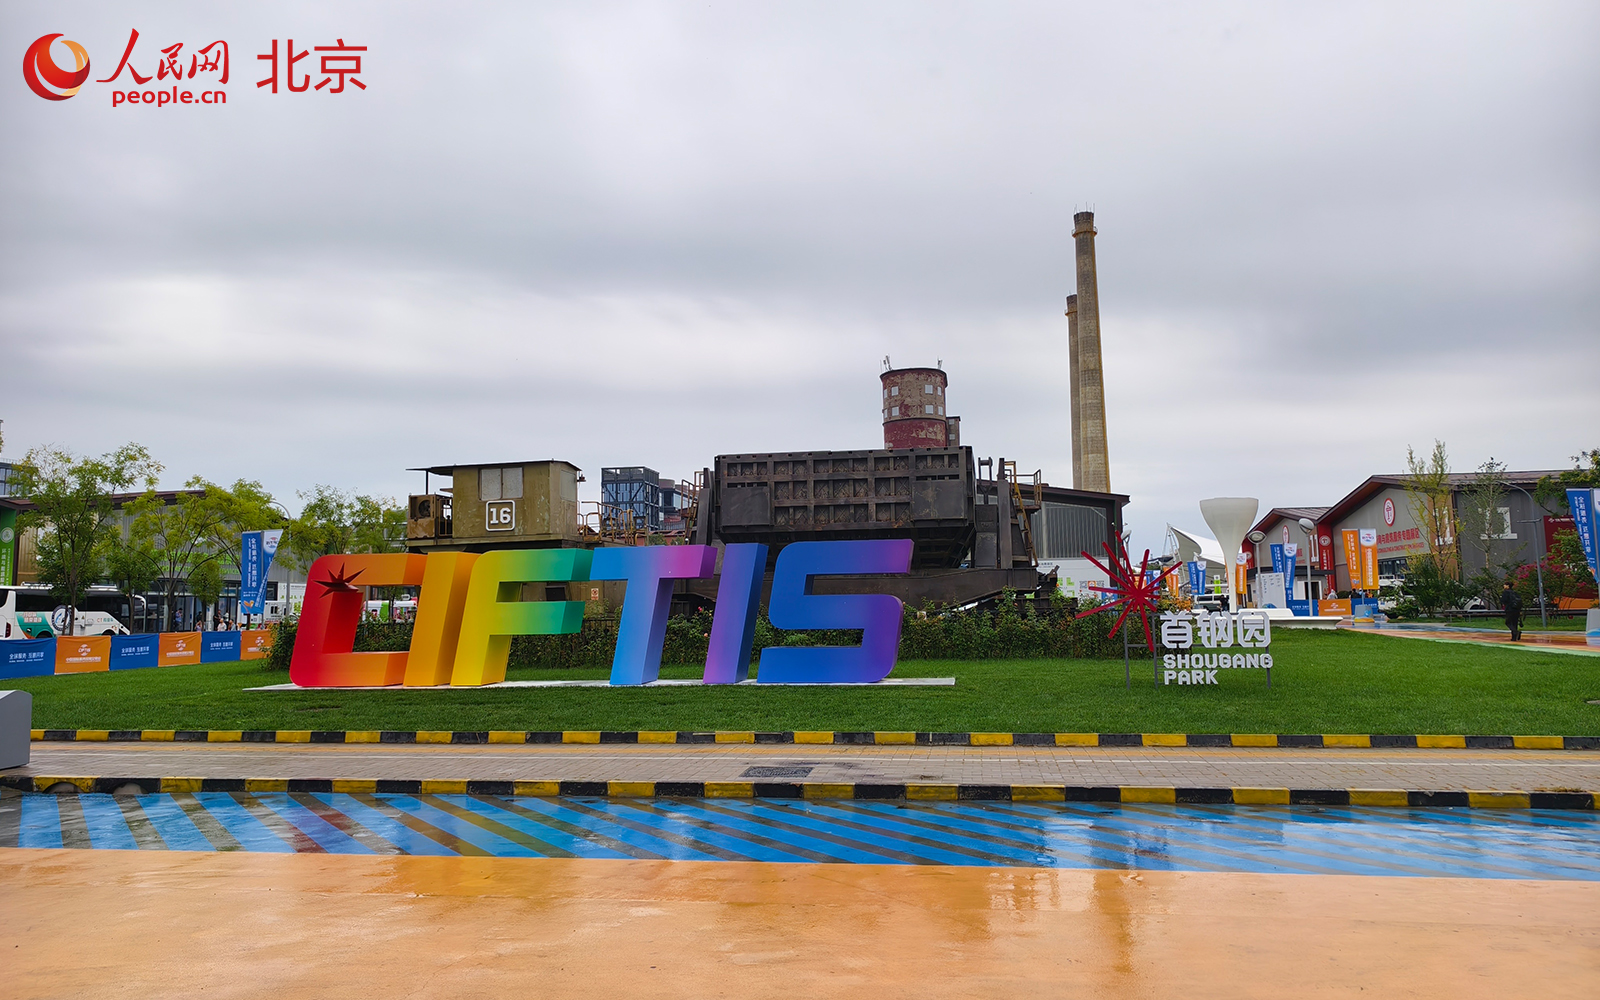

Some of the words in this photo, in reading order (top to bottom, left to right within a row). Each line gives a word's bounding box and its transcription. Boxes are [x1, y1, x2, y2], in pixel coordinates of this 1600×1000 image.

[490, 508, 511, 525] 16
[288, 539, 914, 687] CIFTIS
[1160, 611, 1271, 648] 首钢园
[1163, 654, 1273, 669] SHOUGANG
[1164, 670, 1218, 685] PARK
